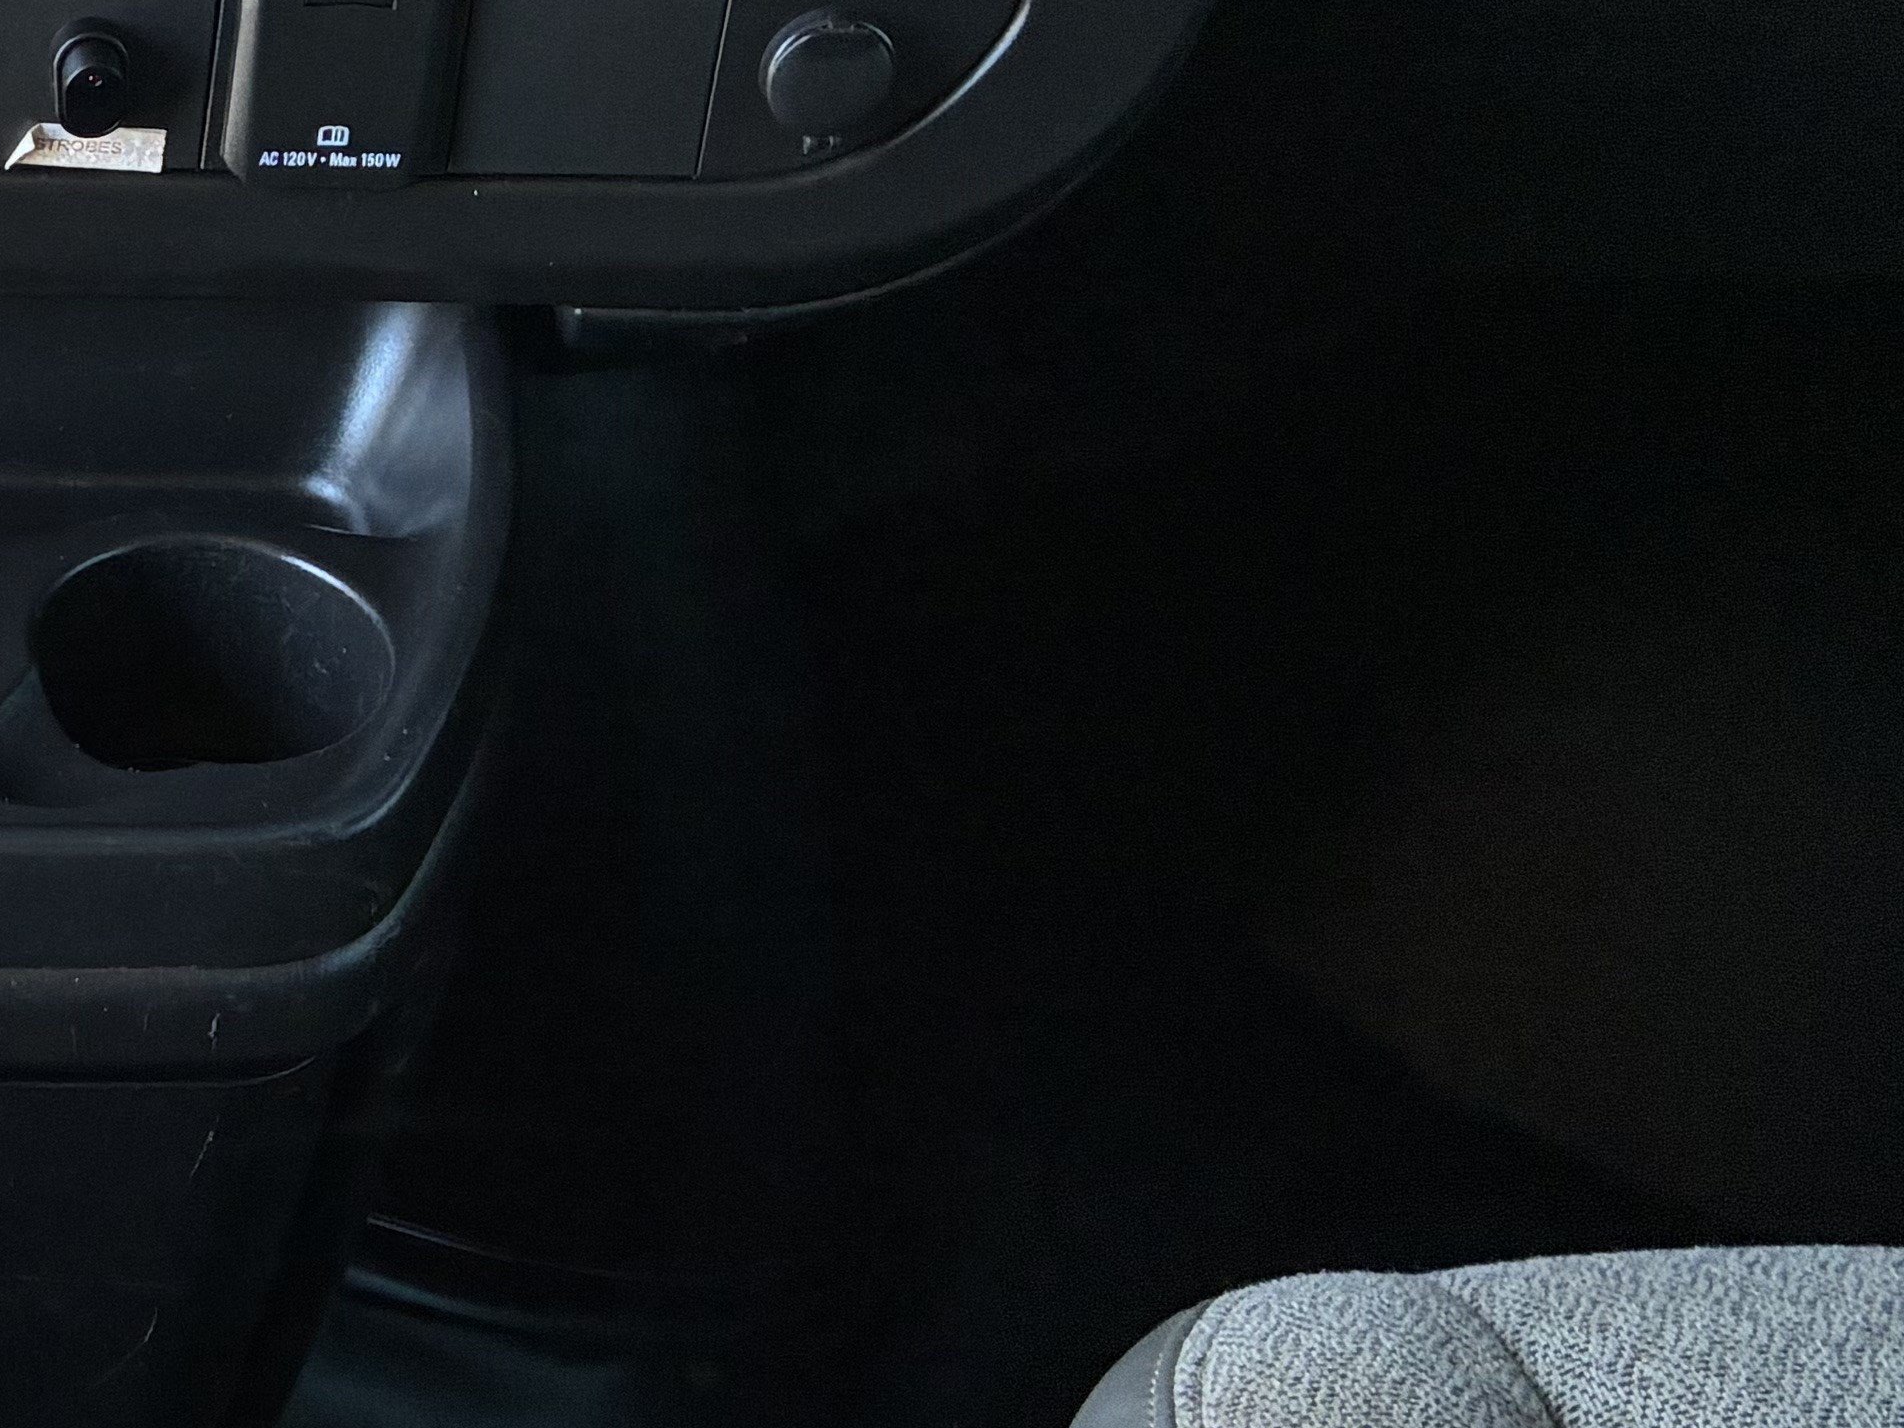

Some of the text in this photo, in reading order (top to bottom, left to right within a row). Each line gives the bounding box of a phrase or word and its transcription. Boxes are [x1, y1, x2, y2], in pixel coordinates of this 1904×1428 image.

[35, 137, 123, 155] STROBES
[258, 151, 280, 167] AC
[329, 152, 358, 167] Max
